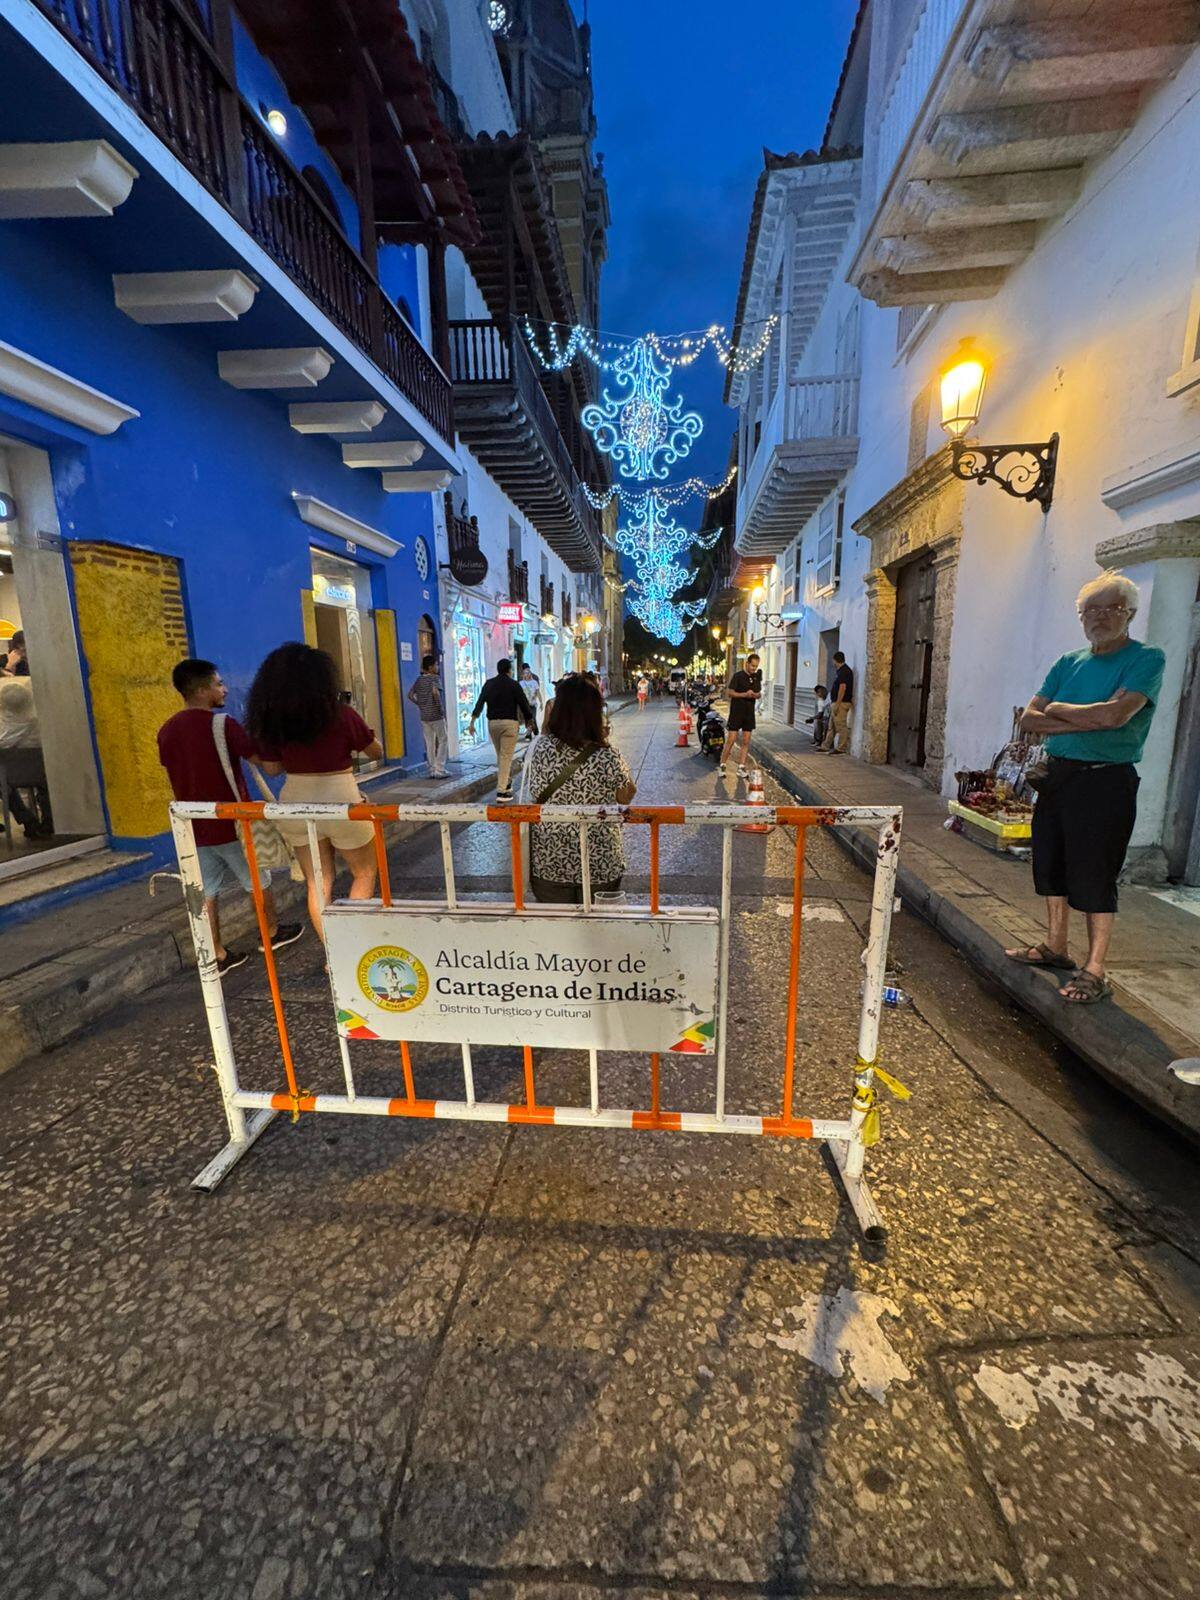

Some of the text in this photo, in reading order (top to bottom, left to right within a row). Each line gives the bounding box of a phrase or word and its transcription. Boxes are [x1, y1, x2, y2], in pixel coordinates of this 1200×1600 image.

[435, 949, 646, 977] Alcaldía Mayor de
[436, 977, 676, 1002] Cartagena de Indias
[440, 1004, 481, 1015] Distrito
[535, 1009, 542, 1018] y
[545, 1008, 592, 1019] Cultural
